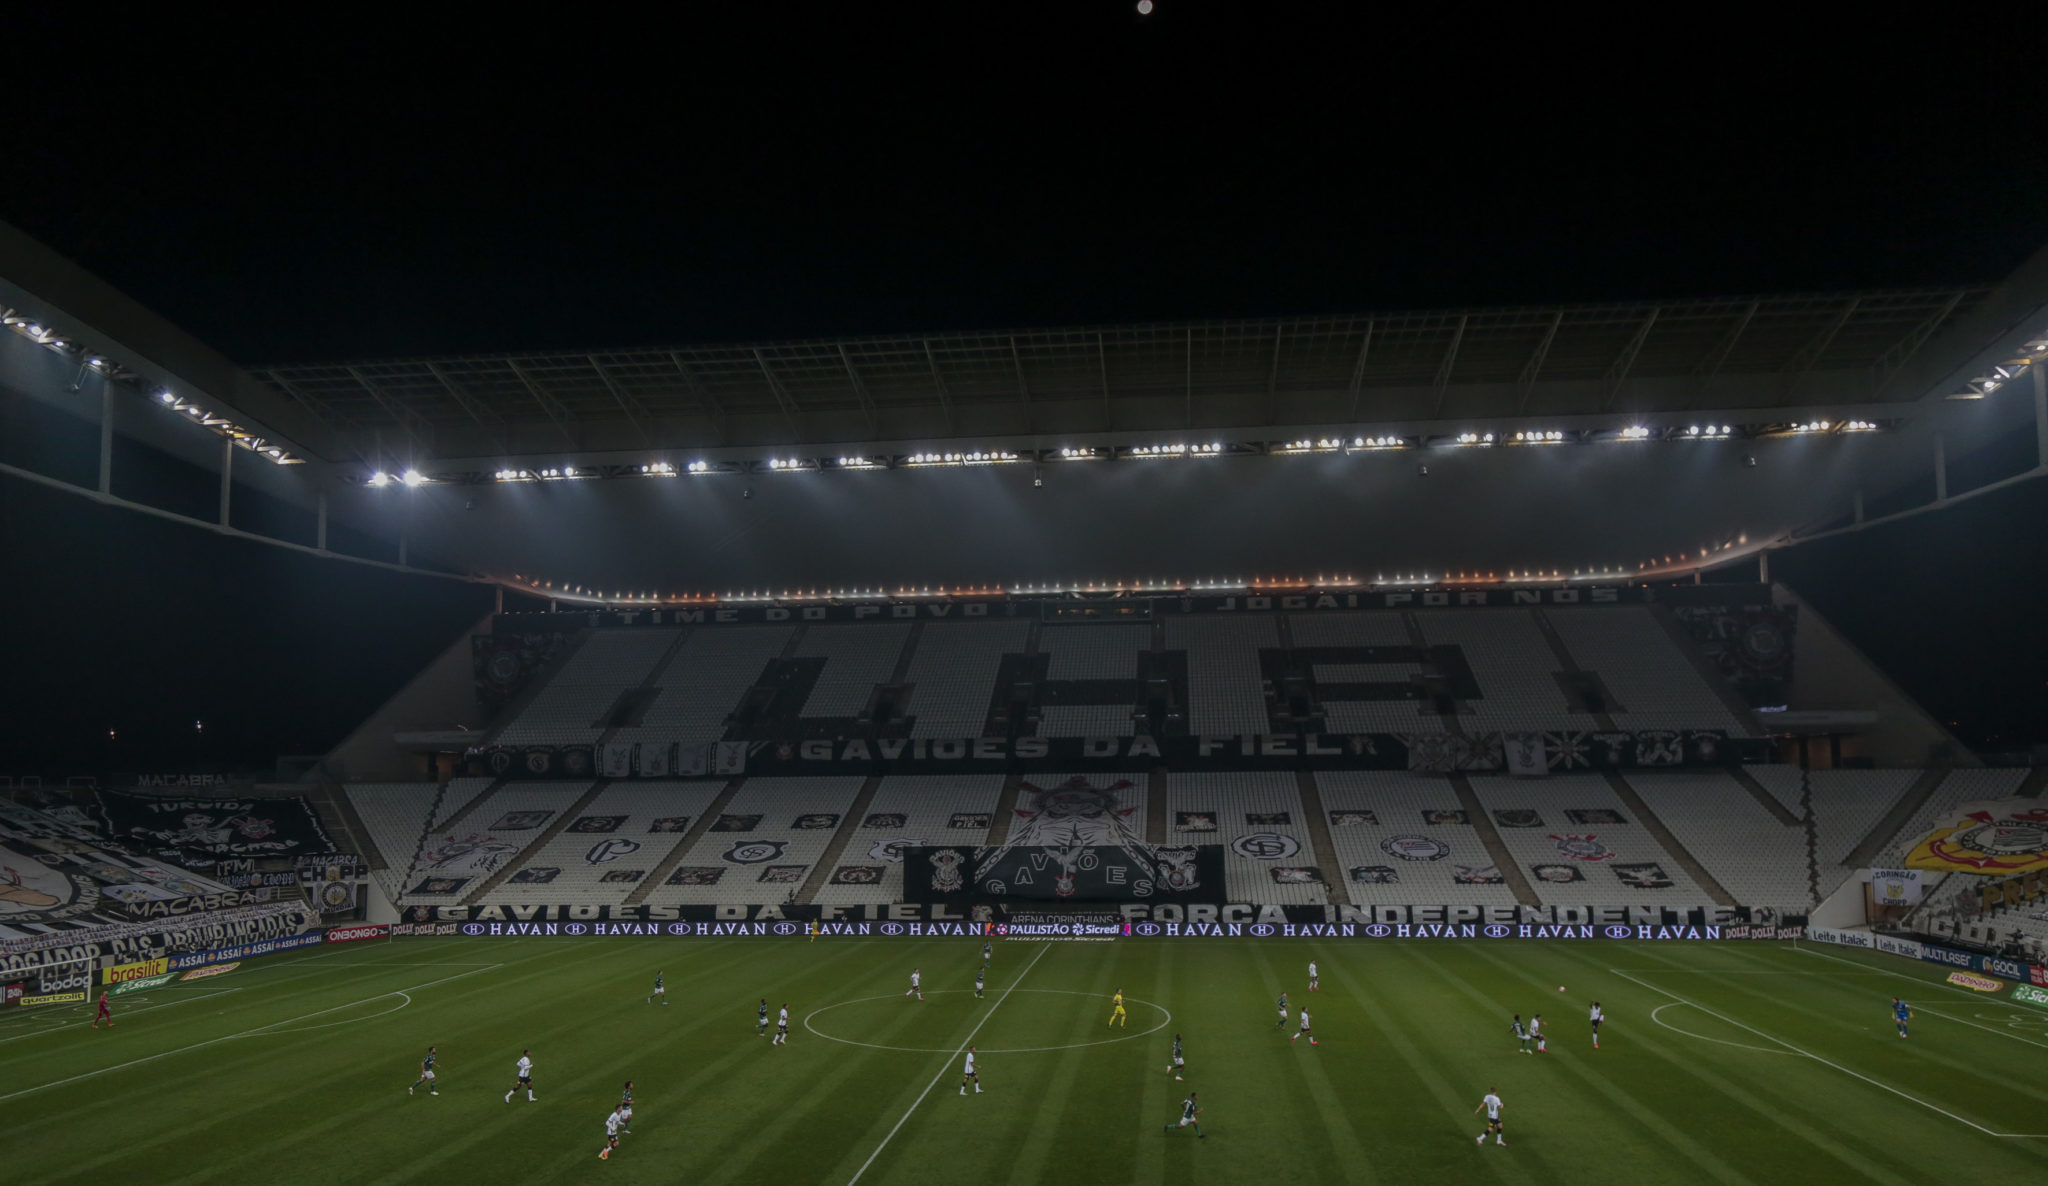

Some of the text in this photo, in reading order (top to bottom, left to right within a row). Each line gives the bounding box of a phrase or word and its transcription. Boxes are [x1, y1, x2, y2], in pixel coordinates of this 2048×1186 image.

[618, 603, 988, 625] TIME DO POVO
[1083, 737, 1160, 758] DA
[1200, 735, 1343, 757] FIEL
[129, 890, 256, 917] MACABRA
[716, 904, 785, 920] DA
[822, 904, 964, 920] FIEL
[1011, 914, 1113, 923] ARENA CORINTHIANS
[329, 927, 378, 941] ONBONGO
[393, 924, 413, 935] DOLLY
[415, 924, 435, 935] DOLLY
[437, 924, 457, 935] DOLLY
[490, 923, 557, 935] HAVAN
[595, 923, 659, 935] HAVAN
[695, 923, 766, 935] HAVAN
[804, 923, 870, 935] HAVAN
[909, 923, 982, 935] HAVAN
[1009, 924, 1120, 934] PAULISTÃO Sicredi
[1166, 923, 1242, 936] HAVAN
[1283, 924, 1356, 937] HAVAN
[1396, 924, 1476, 938] HAVAN
[1519, 925, 1594, 938] HAVAN
[1637, 925, 1720, 939] HAVAN
[1725, 926, 1750, 938] DOLLY
[1751, 926, 1776, 939] DOLLY
[1777, 926, 1802, 939] DOLLY
[1813, 930, 1868, 946] Leite Italac
[1880, 939, 1896, 951] Leite
[110, 960, 161, 983] brasilit
[1993, 960, 2021, 976] GOCIL
[41, 974, 90, 992] bodog
[22, 994, 83, 1005] quartzolit
